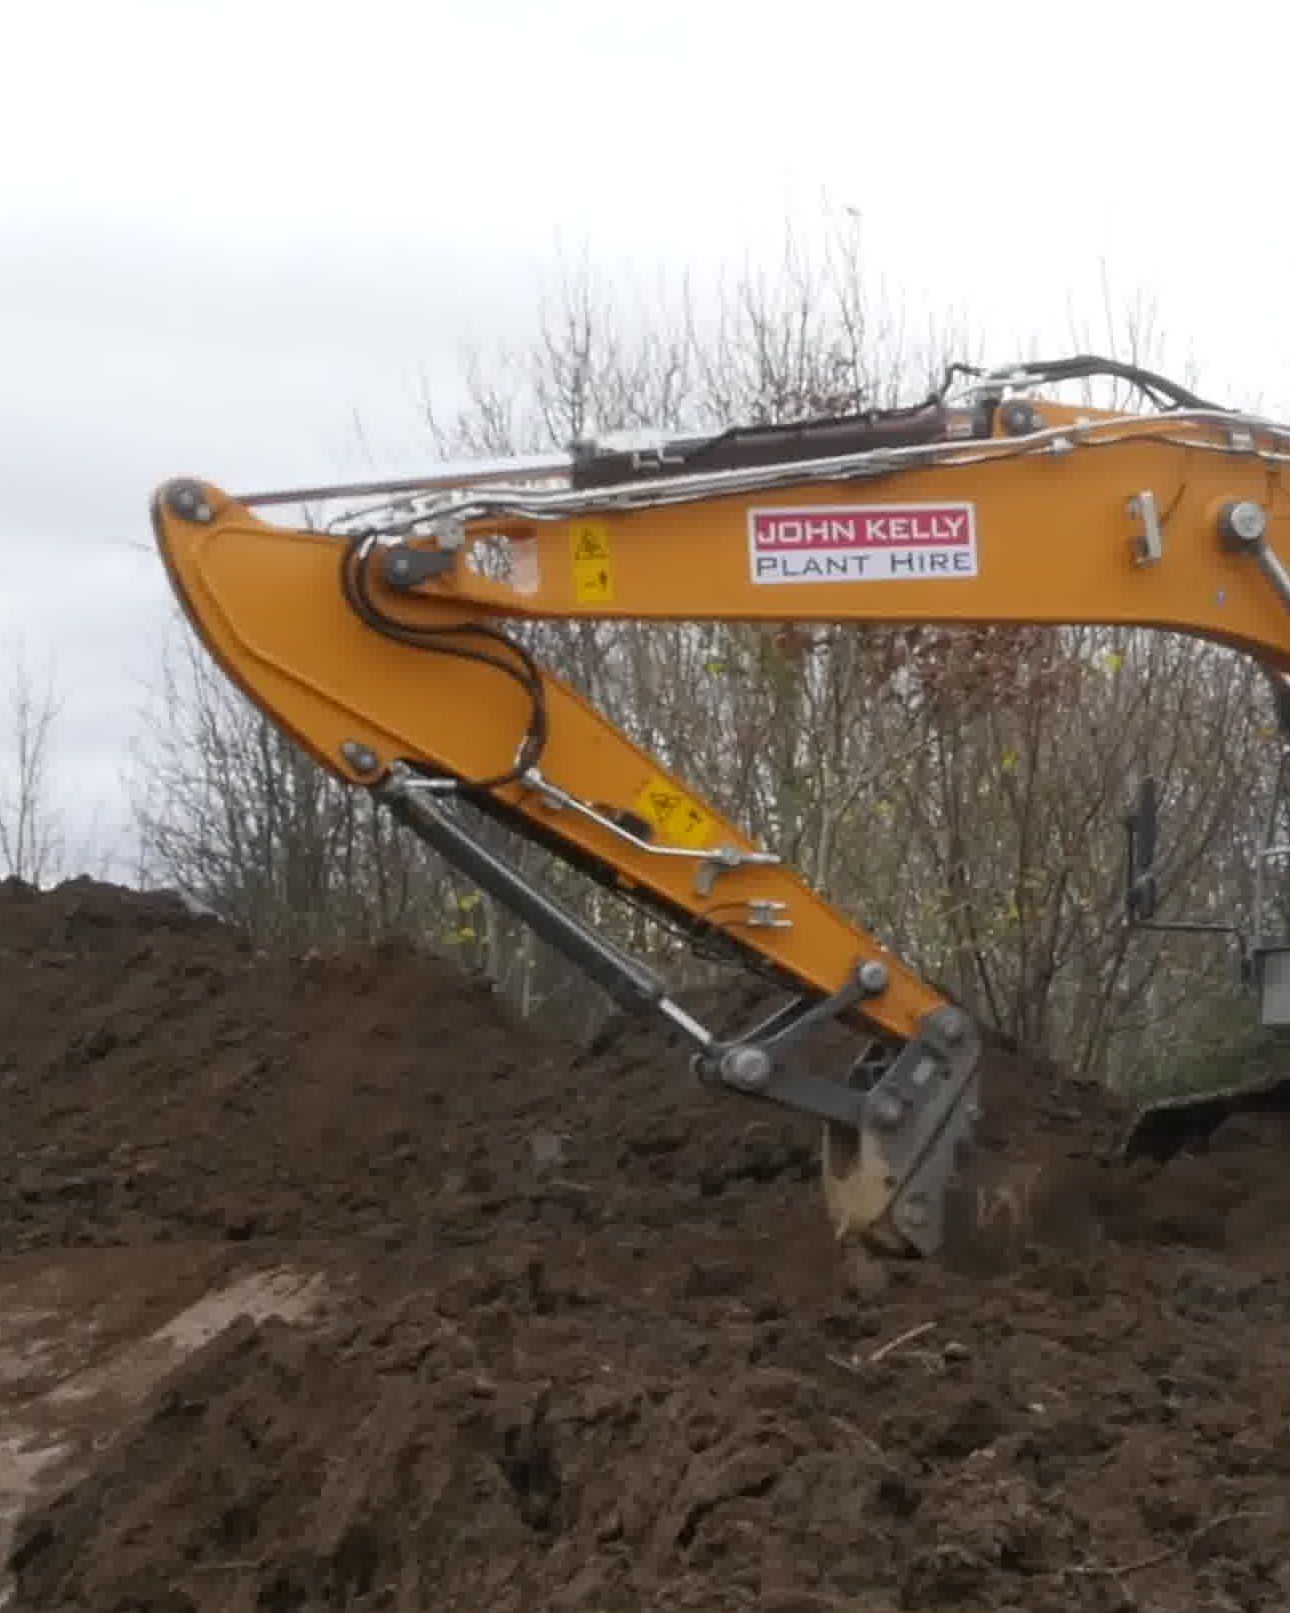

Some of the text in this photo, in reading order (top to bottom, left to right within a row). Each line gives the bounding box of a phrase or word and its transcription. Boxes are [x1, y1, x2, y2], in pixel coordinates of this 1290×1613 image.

[757, 514, 966, 545] JOHN KELLY
[756, 551, 971, 578] PLANT HIRE
